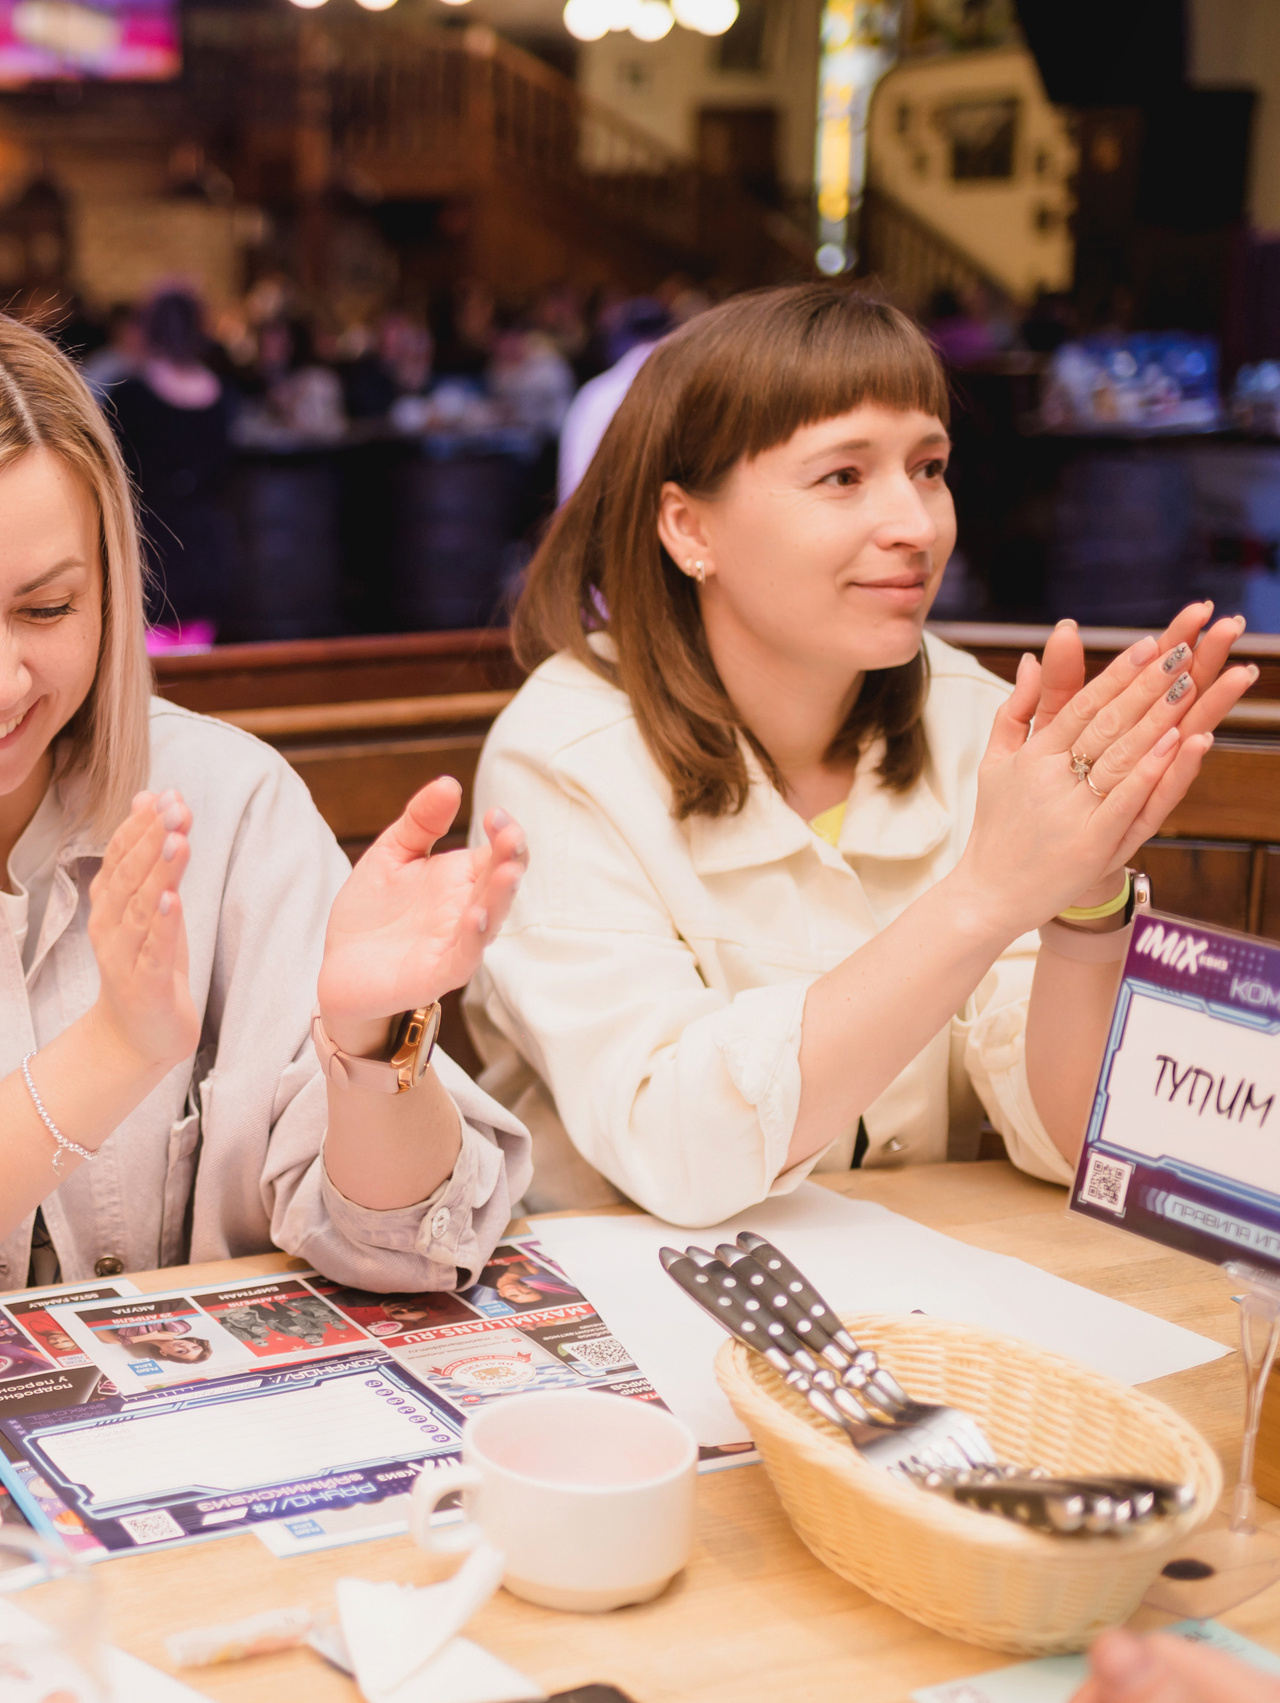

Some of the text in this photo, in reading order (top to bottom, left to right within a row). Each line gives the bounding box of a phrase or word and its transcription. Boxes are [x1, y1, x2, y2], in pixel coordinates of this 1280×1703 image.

[1172, 1201, 1251, 1241] ПРАВИЛА
[219, 1285, 280, 1301] БИРТМАН
[111, 1304, 155, 1315] АКУЛА
[227, 1297, 271, 1309] АПРЕЛЯ
[111, 1313, 158, 1325] АПРЕЛЯ
[403, 1306, 587, 1344] MAXIMILIANS.RU
[376, 1469, 417, 1482] КВИЗ
[197, 1473, 364, 1512] #АЙМИКСКВИЗ
